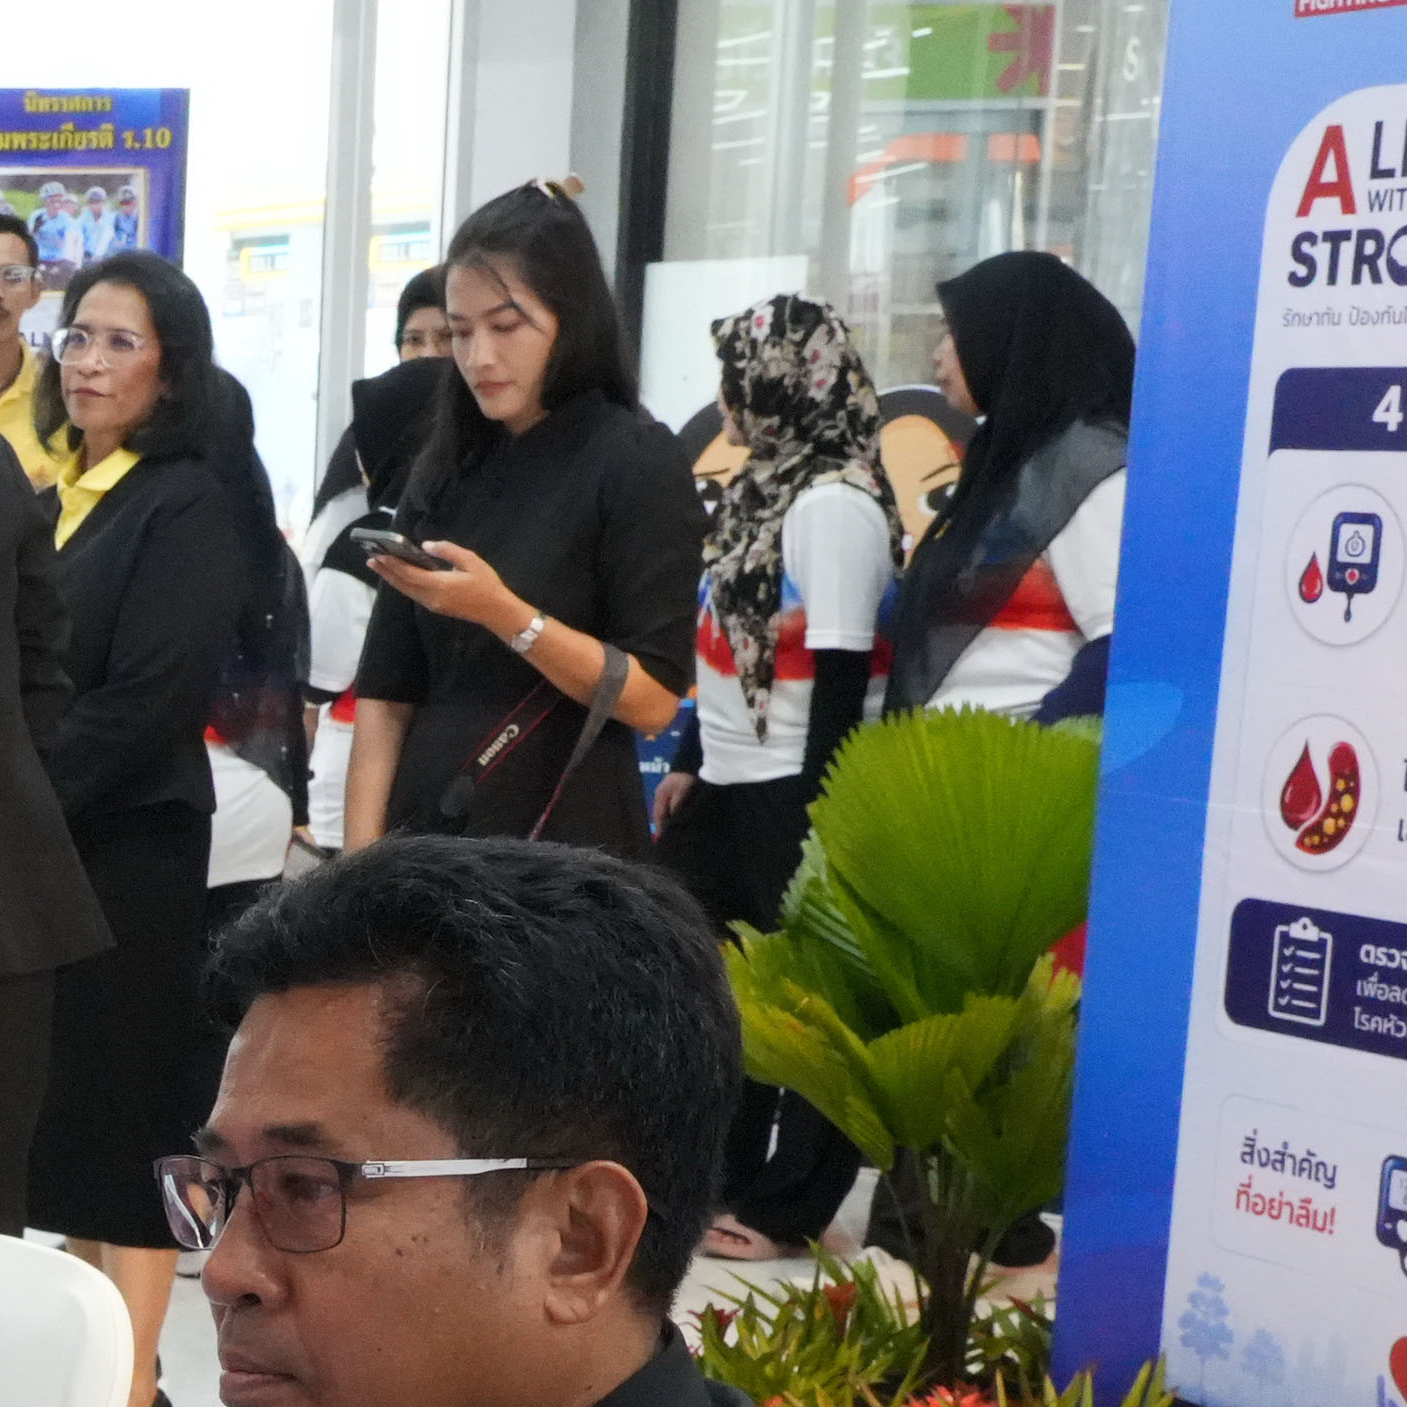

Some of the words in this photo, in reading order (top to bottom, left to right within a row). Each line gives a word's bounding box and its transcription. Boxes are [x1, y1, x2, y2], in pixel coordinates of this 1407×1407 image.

[1295, 124, 1357, 218] A
[1372, 385, 1404, 432] 4
[477, 724, 520, 766] Canon
[1240, 1128, 1337, 1190] สิ่งสำคัญ
[1235, 1174, 1337, 1236] ที่อย่าลืม!
